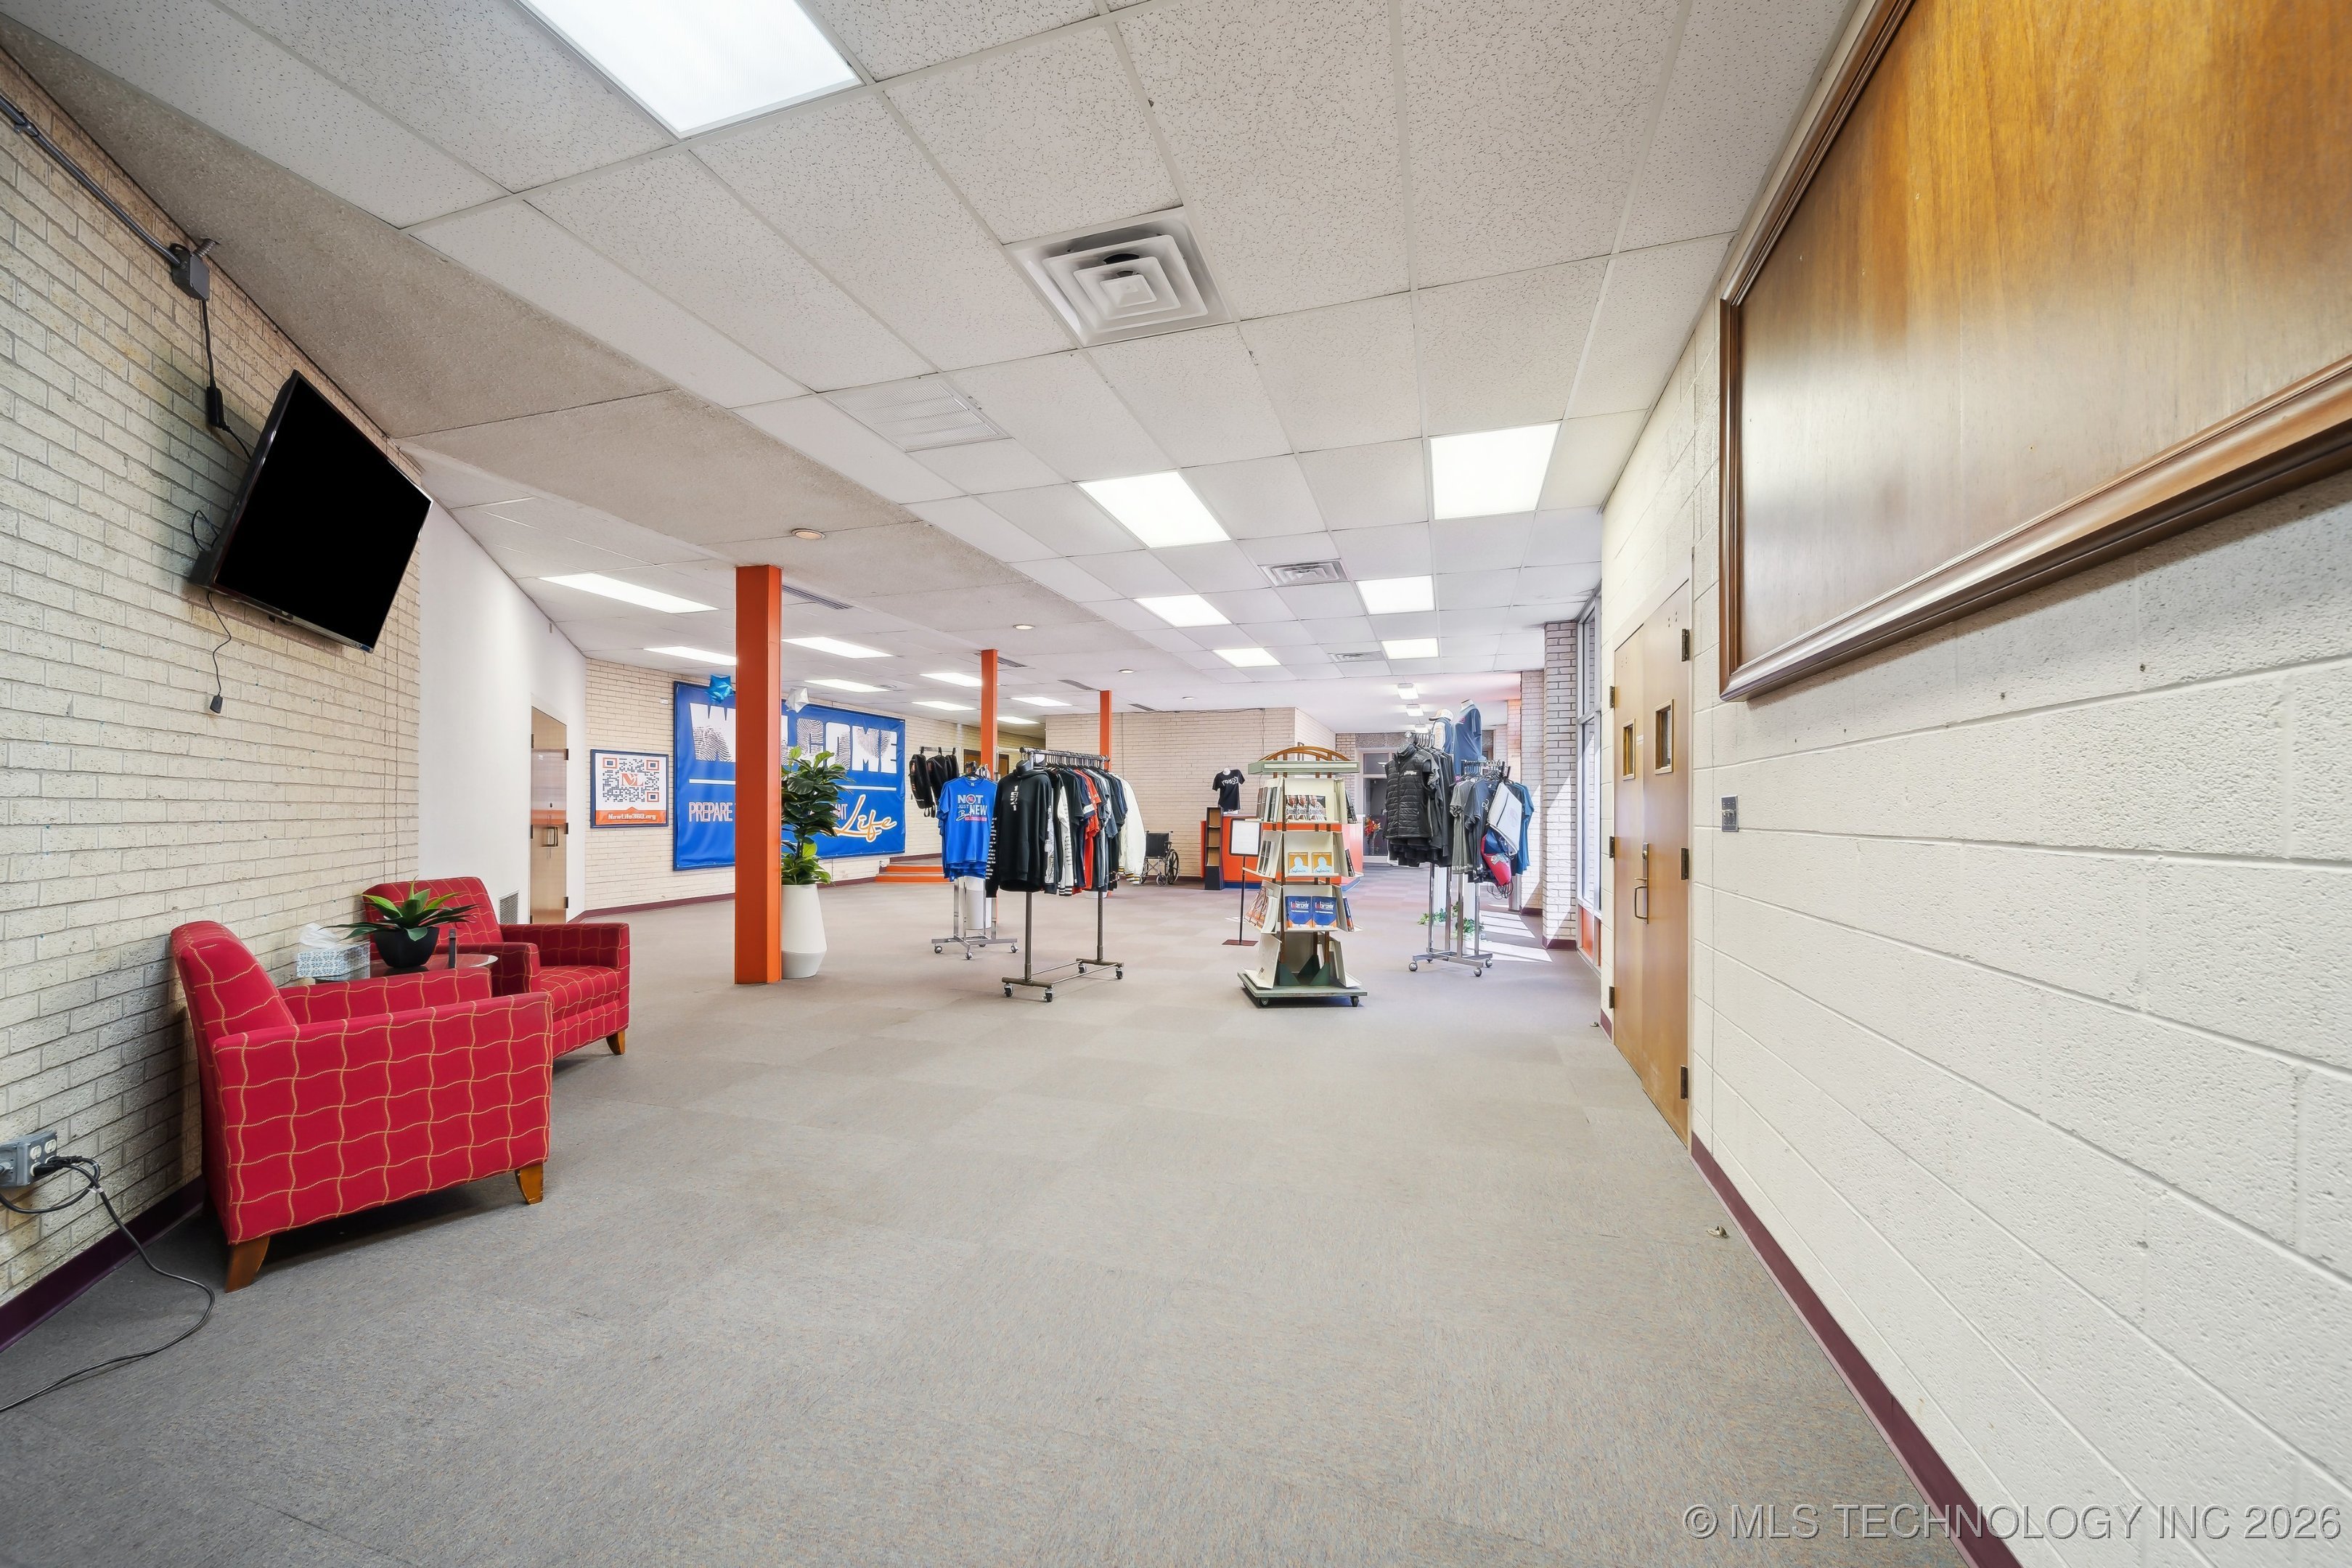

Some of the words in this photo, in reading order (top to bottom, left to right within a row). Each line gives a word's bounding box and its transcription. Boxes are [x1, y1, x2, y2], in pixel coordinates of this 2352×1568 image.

[690, 703, 897, 774] WLCOME
[957, 793, 984, 804] NOT
[689, 801, 733, 822] PREPARE
[825, 794, 897, 842] Life
[969, 804, 988, 816] NEW
